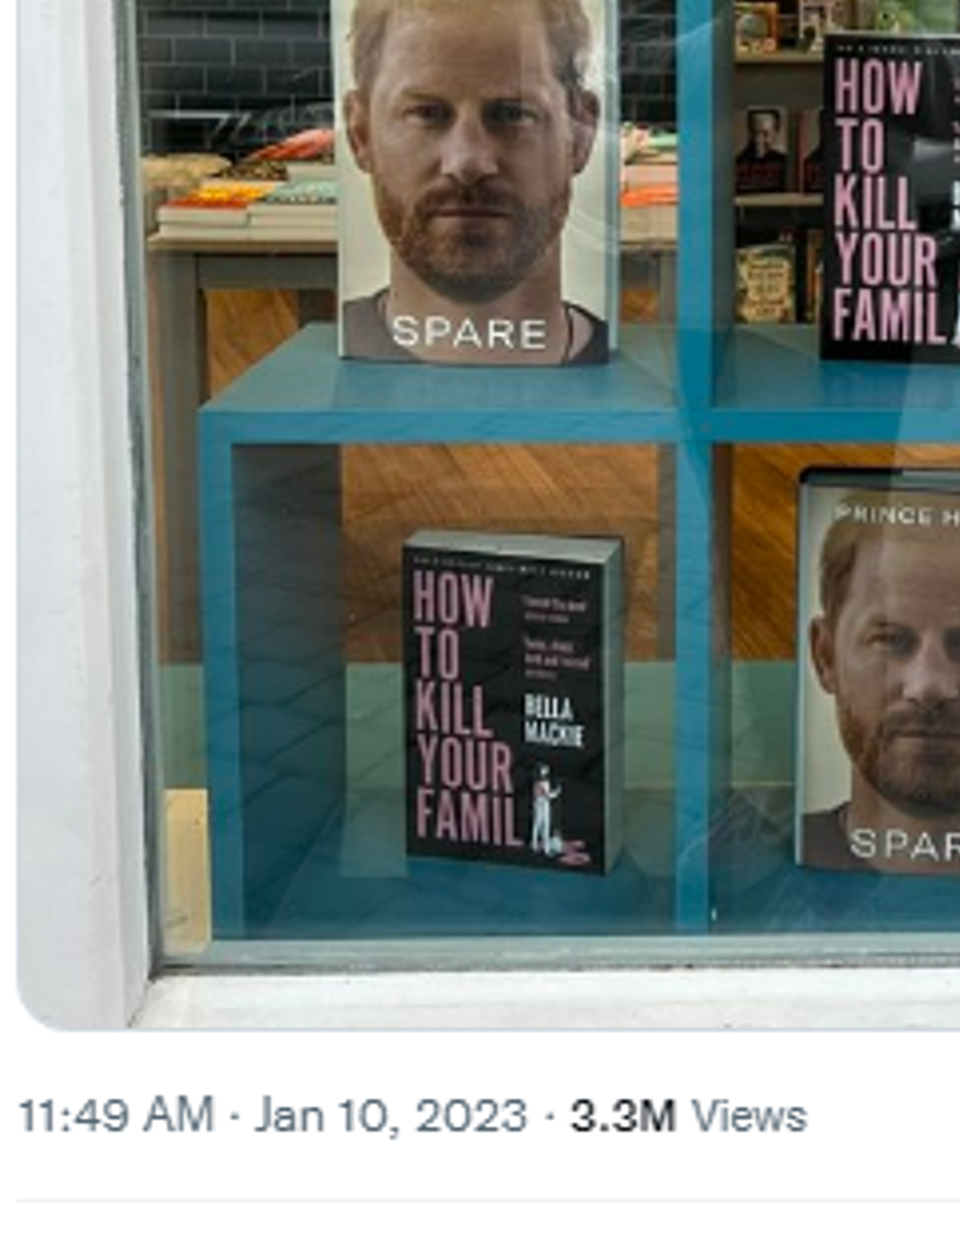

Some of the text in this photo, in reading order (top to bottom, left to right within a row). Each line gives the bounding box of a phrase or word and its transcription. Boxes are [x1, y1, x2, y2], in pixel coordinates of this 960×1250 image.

[834, 57, 923, 115] HOW
[834, 117, 884, 174] TO
[834, 172, 918, 230] KILL
[834, 231, 938, 288] YOUR
[393, 317, 547, 349] SPARE
[834, 505, 931, 524] PRINCE
[413, 570, 494, 627] HOW
[414, 626, 460, 680] TO
[415, 681, 494, 738] KILL
[524, 693, 573, 721] BELLA
[524, 720, 585, 747] MACKIE
[416, 733, 514, 794] YOUR
